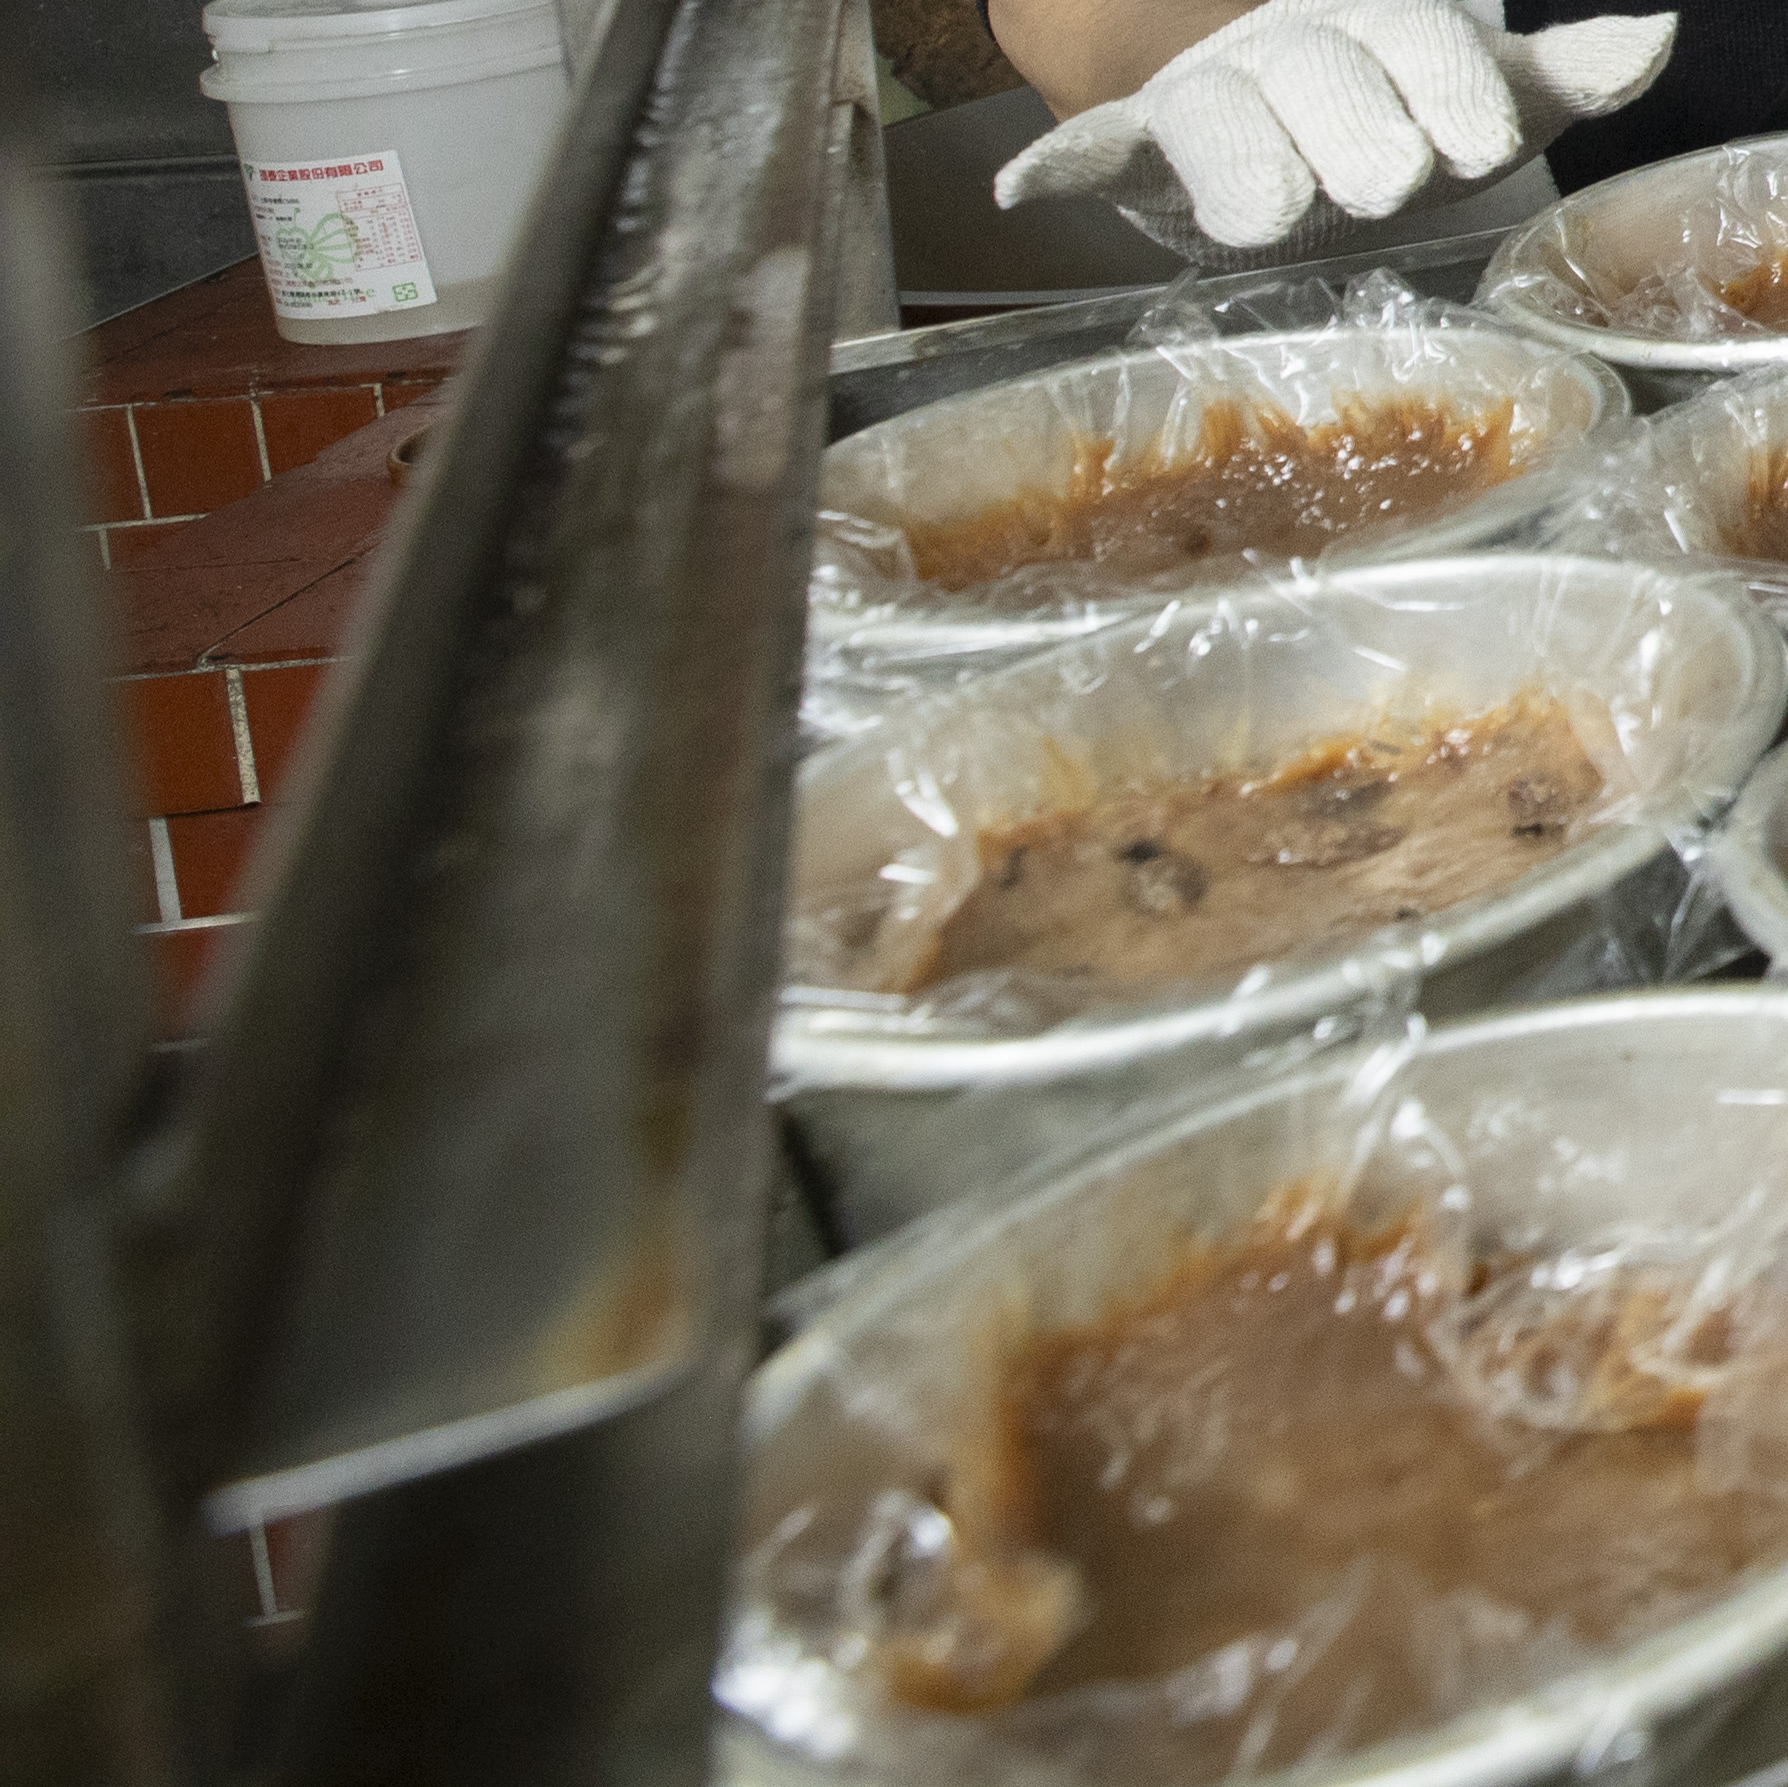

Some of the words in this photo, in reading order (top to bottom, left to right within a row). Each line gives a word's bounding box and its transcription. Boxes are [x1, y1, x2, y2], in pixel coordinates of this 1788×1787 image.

[259, 159, 384, 182] 企業股份有限公司
